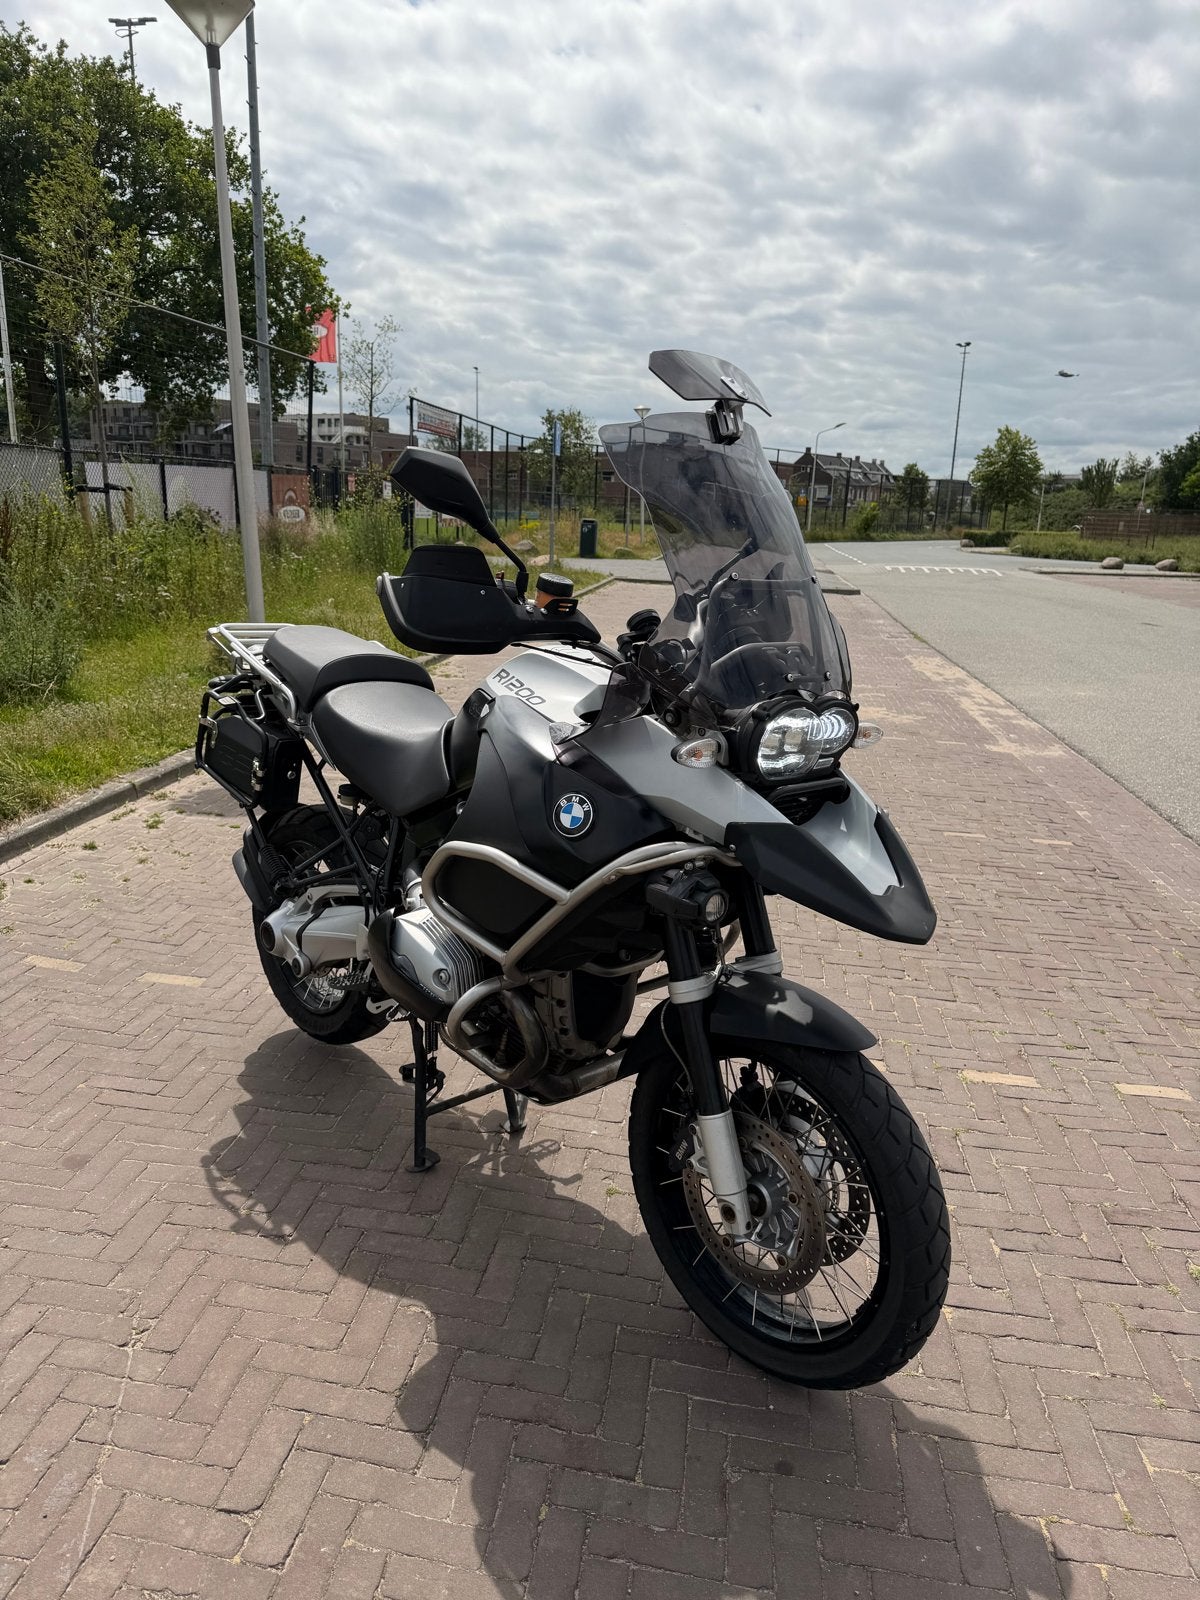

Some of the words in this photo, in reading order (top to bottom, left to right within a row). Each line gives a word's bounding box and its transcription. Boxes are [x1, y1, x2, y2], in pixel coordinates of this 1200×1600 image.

[492, 668, 546, 705] R1200
[560, 796, 590, 811] BMW
[675, 1139, 688, 1161] BMW
